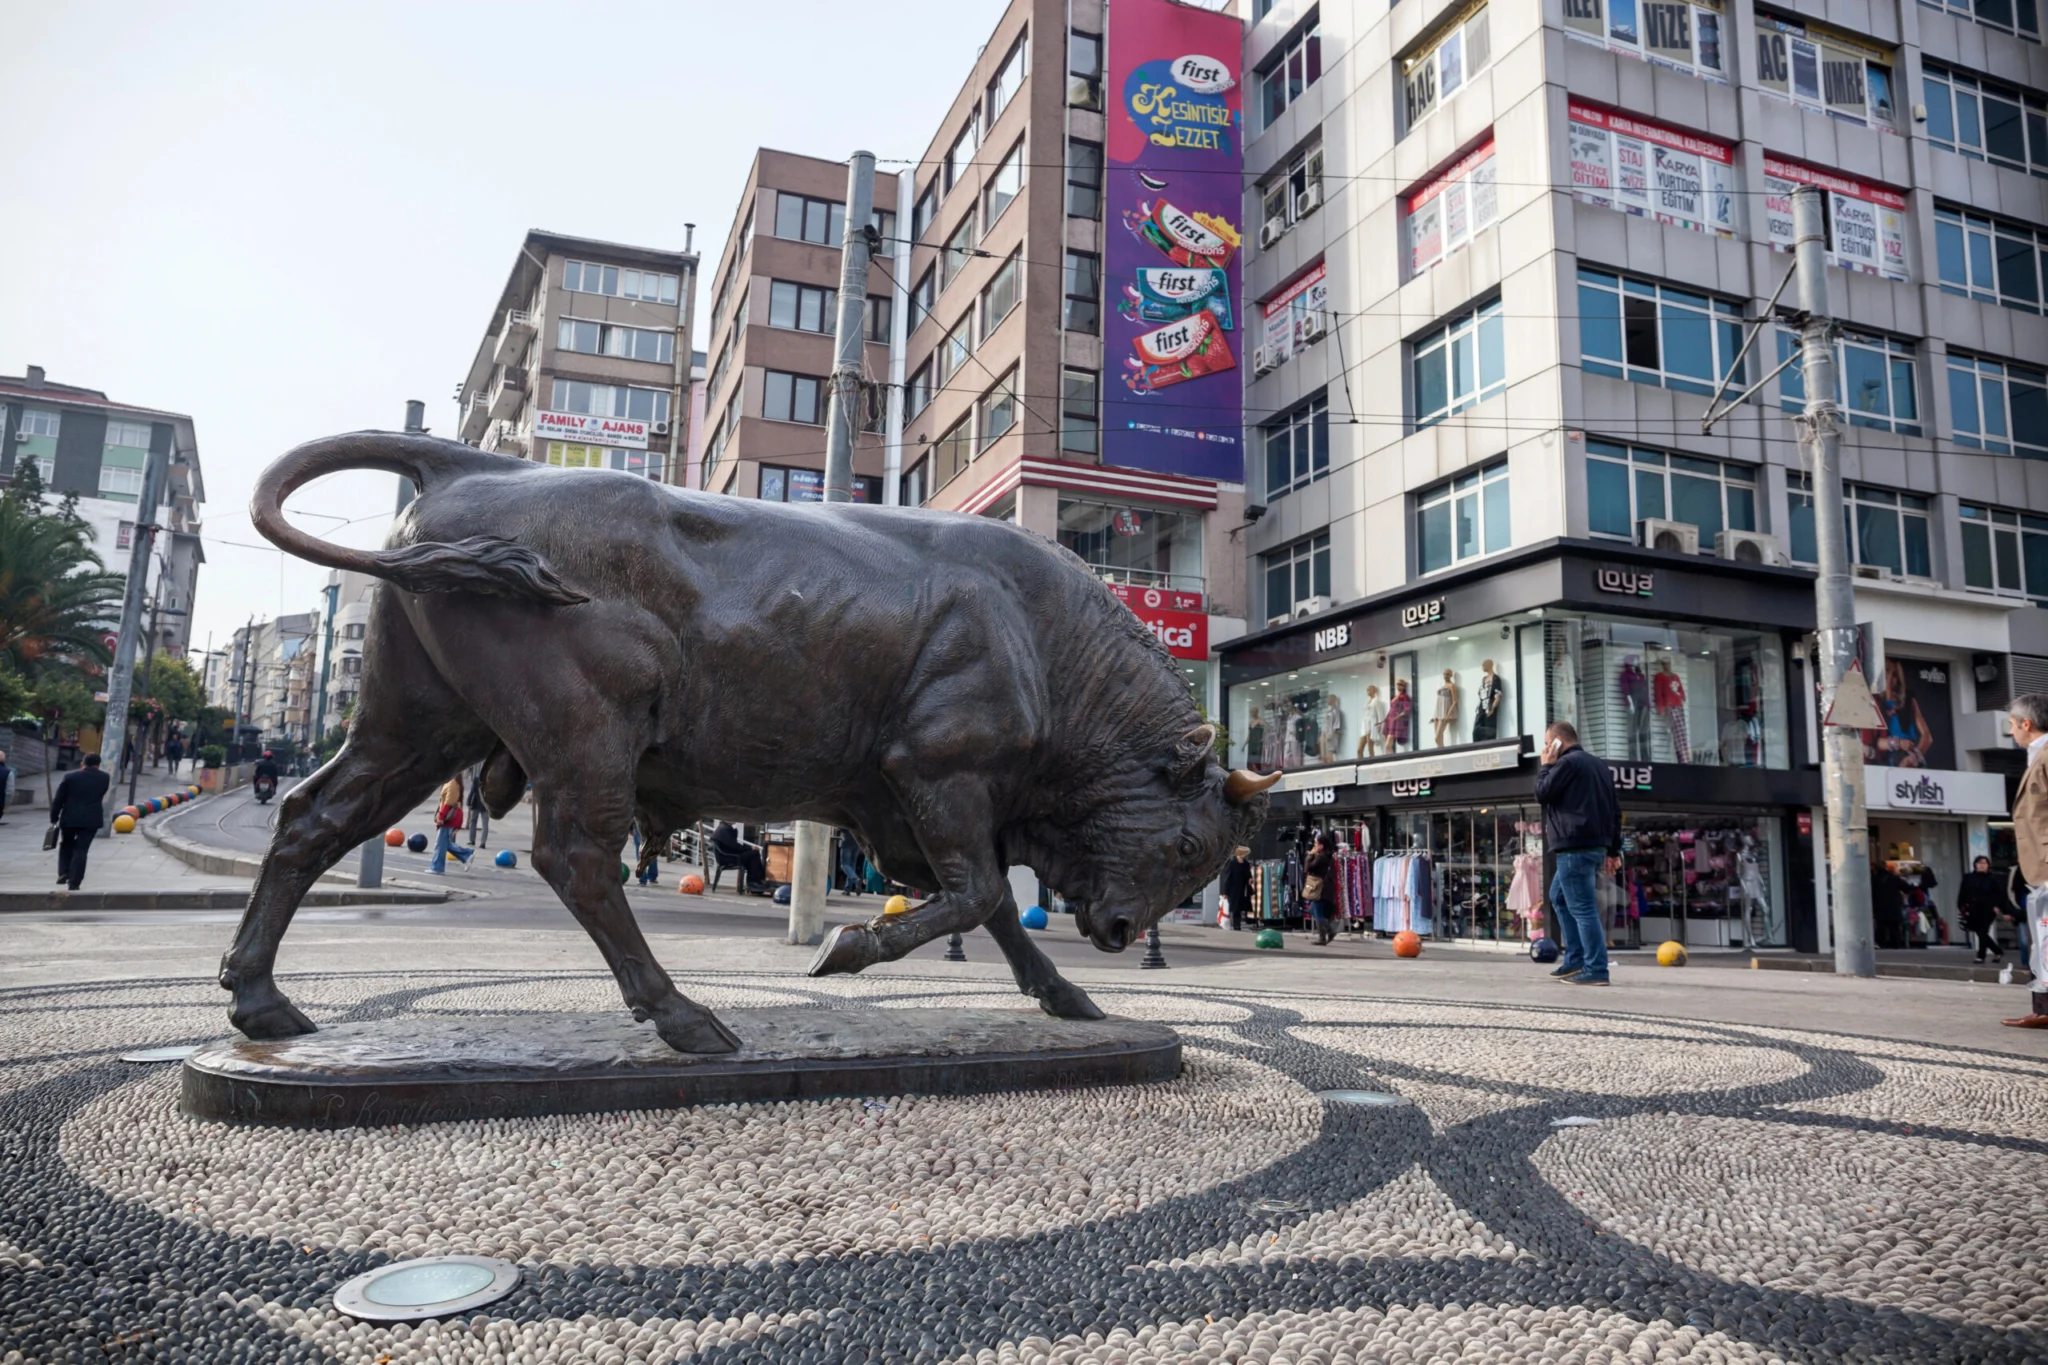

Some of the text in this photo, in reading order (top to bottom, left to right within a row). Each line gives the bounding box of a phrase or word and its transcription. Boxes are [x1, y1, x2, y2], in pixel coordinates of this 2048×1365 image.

[1643, 3, 1691, 49] VİZE
[1181, 60, 1220, 82] first
[1758, 34, 1788, 82] AC
[1132, 83, 1231, 127] KESİNTİSİZ
[1408, 59, 1435, 127] HAC
[1619, 148, 1643, 168] STAJ
[1655, 150, 1700, 178] KARYA
[1169, 215, 1206, 244] first
[1159, 271, 1196, 291] first
[1155, 325, 1190, 352] first
[540, 413, 643, 435] FAMILY AJANS
[1315, 624, 1348, 652] NBB
[1608, 766, 1652, 789] oya
[1302, 785, 1335, 806] NBB
[1896, 780, 1944, 805] stylish
